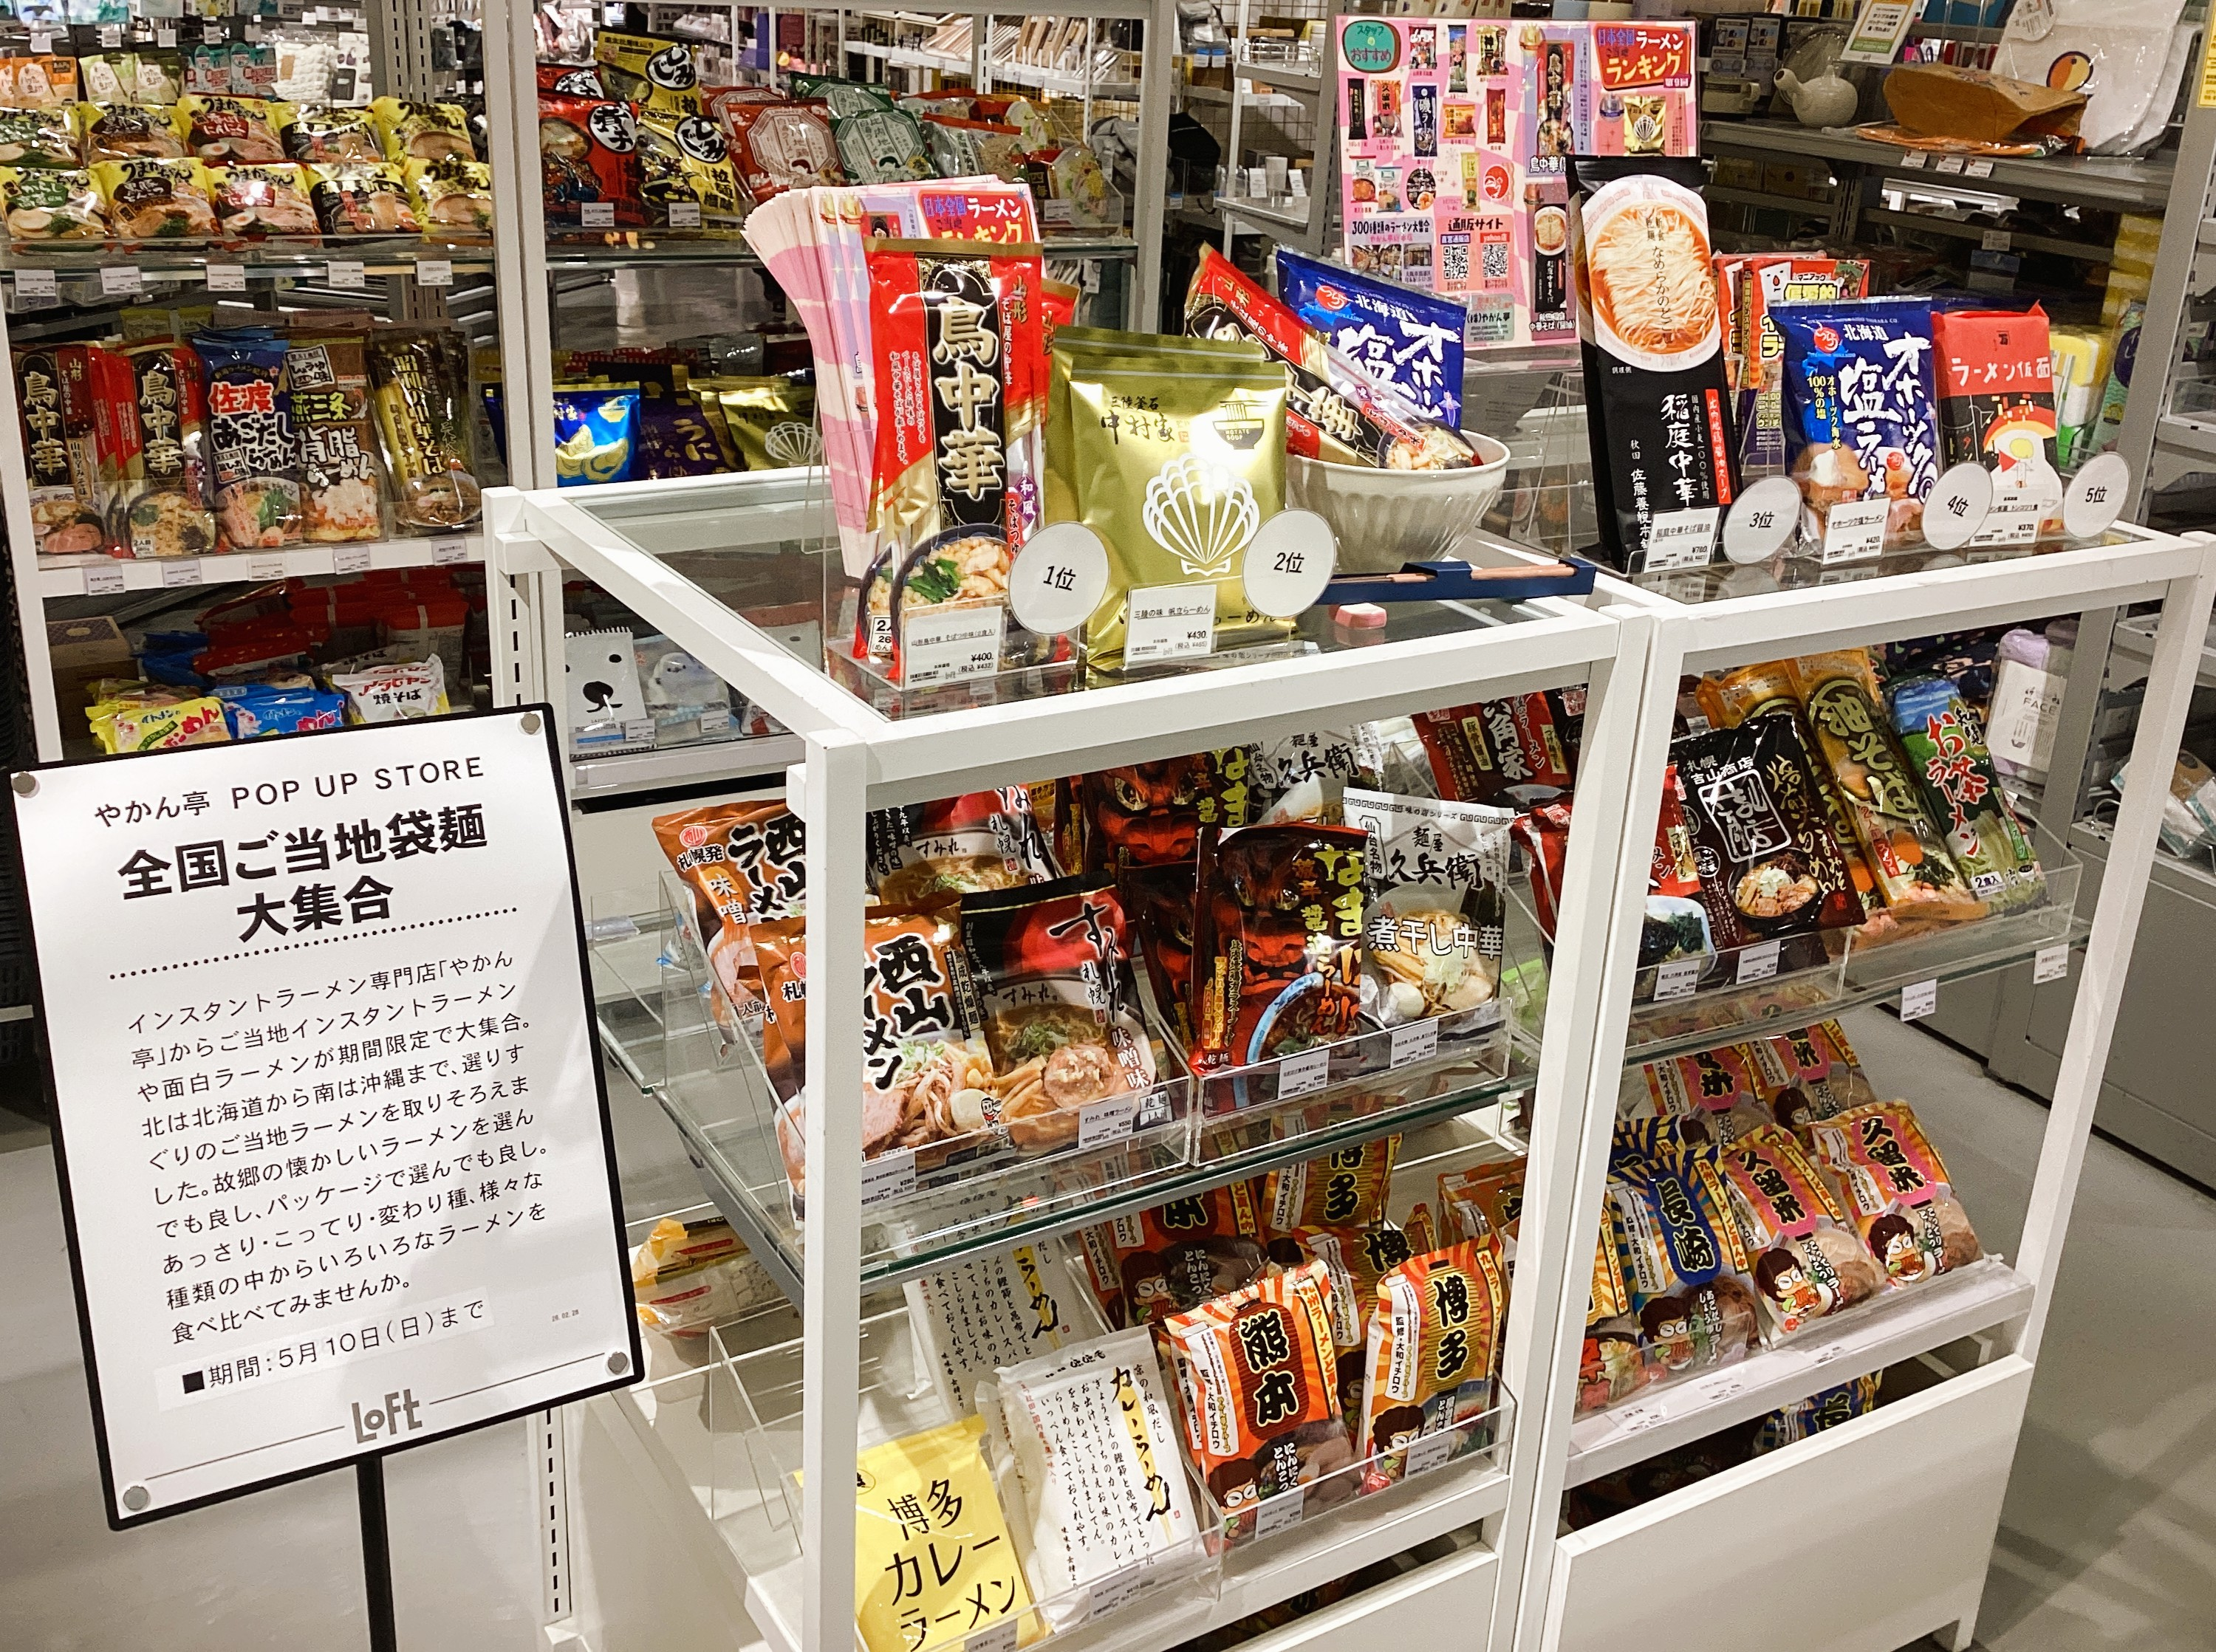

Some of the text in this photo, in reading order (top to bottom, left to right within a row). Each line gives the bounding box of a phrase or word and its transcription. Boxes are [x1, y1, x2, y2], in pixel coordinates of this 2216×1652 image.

[1356, 24, 1385, 35] スタッフ
[1635, 31, 1684, 50] ラーメン
[1350, 47, 1392, 64] おすすめ
[1606, 50, 1684, 83] ランキング
[968, 197, 1021, 219] ラーメン
[1447, 217, 1505, 232] 通販サイト
[1010, 274, 1029, 324] 山形
[1797, 273, 1827, 282] マニアック
[1355, 294, 1418, 323] 北海道
[1844, 323, 1890, 342] 北海道
[1952, 356, 2051, 387] ラーメン仮面
[210, 379, 275, 414] 佐渡
[931, 295, 1006, 501] 鳥中華
[1110, 396, 1160, 411] 三陸釜石
[1807, 376, 1827, 420] 100%の塩
[1826, 375, 1842, 450] オホーツク海水
[22, 371, 67, 477] 鳥中華
[139, 369, 184, 475] 鳥中華
[211, 412, 295, 450] あごだし
[298, 425, 362, 463] 背脂
[1100, 412, 1176, 445] 中村家
[1838, 356, 1904, 501] 塩ラーメ
[1629, 439, 1641, 460] 秋田
[1661, 393, 1698, 507] 稲庭中華
[1019, 479, 1037, 516] 和風
[1947, 494, 1970, 517] 4位
[2085, 486, 2108, 504] 5位
[1748, 510, 1774, 529] 3位
[1042, 565, 1076, 592] 1位
[1273, 551, 1304, 575] 2位
[372, 689, 422, 705] 焼そば
[2022, 696, 2058, 716] FACE
[1278, 742, 1359, 788] 久兵衛
[1690, 756, 1754, 785] 吉山商店
[1928, 711, 1990, 805] お茶
[95, 757, 485, 828] やかん亭 POP UP STORE
[1926, 757, 1980, 857] ラーメン
[117, 803, 488, 901] 全国ご当地袋麺
[916, 837, 960, 858] すみれ
[991, 813, 1016, 855] 札幌
[1364, 820, 1384, 875] 仙台名物
[1411, 826, 1443, 854] 麺屋
[677, 846, 724, 871] 札幌発
[728, 826, 787, 923] ラーメ
[1389, 848, 1485, 891] 久兵衛
[1974, 874, 2000, 888] 2食入
[236, 874, 394, 944] 大集合
[708, 875, 747, 925] 味噌
[1049, 902, 1126, 1022] すみれ
[1368, 915, 1504, 961] 煮干し中華
[129, 950, 513, 1034] インスタントラーメン専門店「やかん
[875, 934, 953, 1034] 西山
[1002, 987, 1053, 1007] すみれ
[1082, 962, 1106, 1005] 札幌
[131, 983, 516, 1069] 亭」からご当地インスタントラーメン
[137, 1012, 530, 1103] や面白ラーメンが期間限定で大集合。
[1112, 1026, 1152, 1091] 味噌味
[142, 1043, 525, 1138] 北は北海道から南は沖縄まで、選りす
[149, 1075, 530, 1171] ぐりのご当地ラーメンを取りそろえま
[154, 1108, 534, 1205] した。故郷の懐かしいラーメンを選ん
[1861, 1117, 1926, 1194] 久留米
[157, 1140, 547, 1238] でも良し、パッケージで選んでも良し。
[1737, 1150, 1807, 1224] 久留米
[163, 1171, 543, 1275] あっさり・こってり・変わり種、様々な
[1656, 1177, 1716, 1272] 長崎
[165, 1202, 546, 1310] 種類の中からいろいろなラーメンを
[1184, 1250, 1203, 1294] とんこつ
[1195, 1248, 1214, 1294] にんにく
[171, 1273, 410, 1345] 食べ比べてみませんか。
[1433, 1274, 1471, 1381] 博多
[1237, 1307, 1301, 1428] 熊本
[1391, 1316, 1405, 1394] 監修・大和イチロウ
[1133, 1363, 1166, 1444] 京の和風だし
[1040, 1397, 1091, 1552] いっぺん食べておくれやす。
[1055, 1391, 1105, 1545] らーめんこしらえましてん。
[1273, 1447, 1291, 1491] とんこつ
[1283, 1442, 1299, 1487] にんにく
[886, 1478, 963, 1541] 博多
[884, 1535, 1001, 1607] カレー
[900, 1575, 1016, 1652] ラーメン
